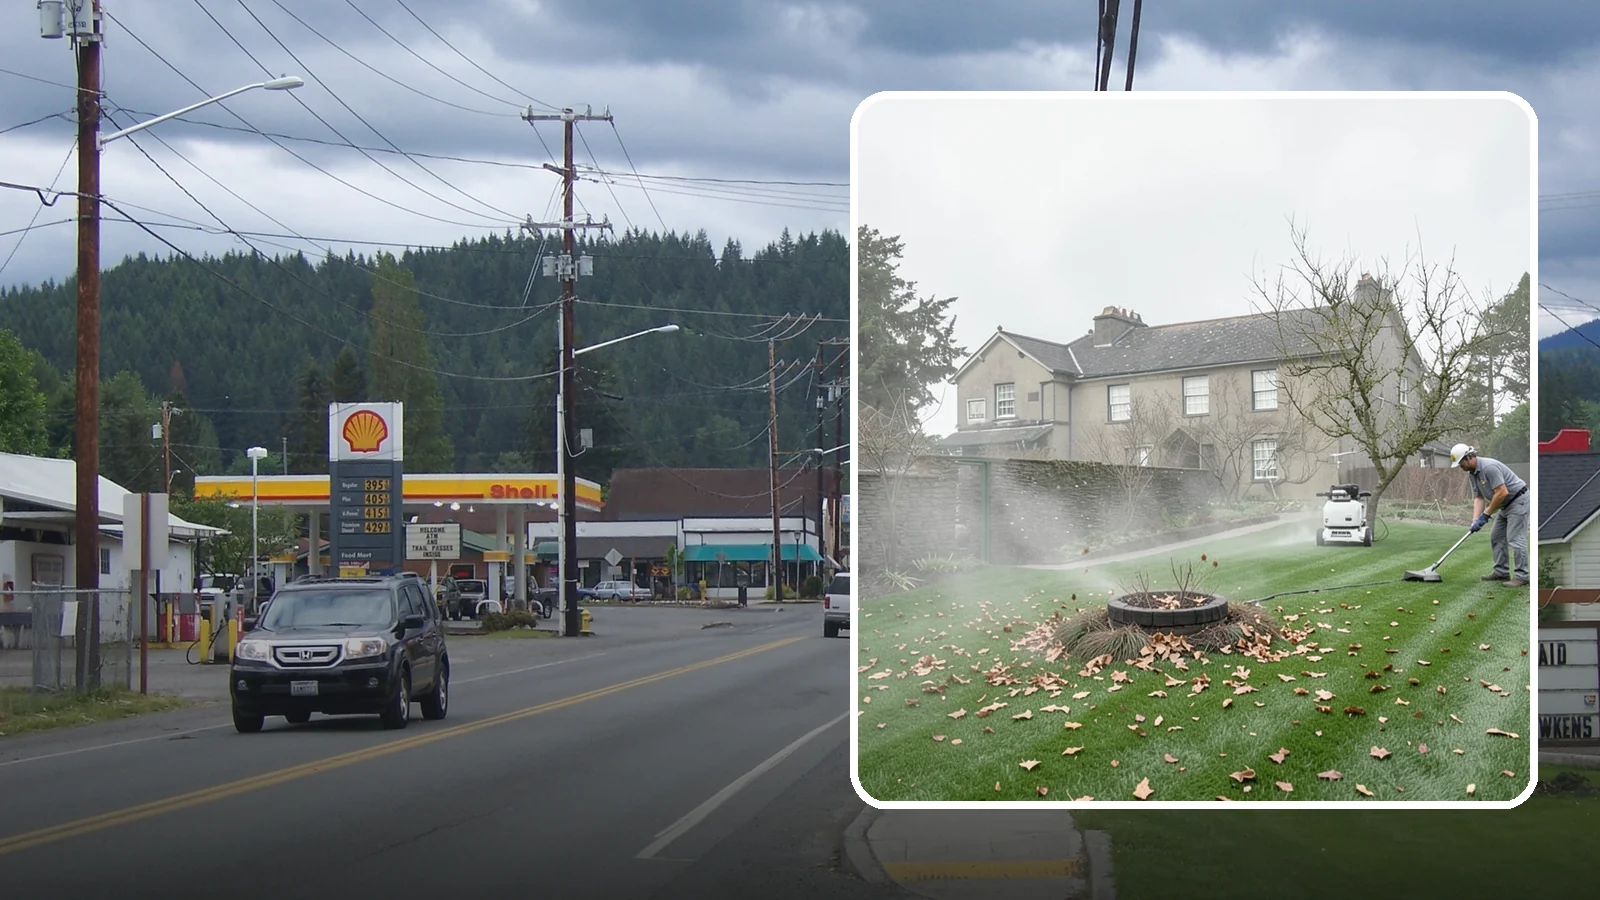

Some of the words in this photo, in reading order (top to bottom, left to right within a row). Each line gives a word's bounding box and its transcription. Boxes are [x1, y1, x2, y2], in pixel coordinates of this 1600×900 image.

[366, 480, 383, 490] 395
[490, 484, 547, 499] Shell
[366, 494, 383, 504] 405
[366, 508, 383, 518] 415
[366, 522, 383, 532] 429
